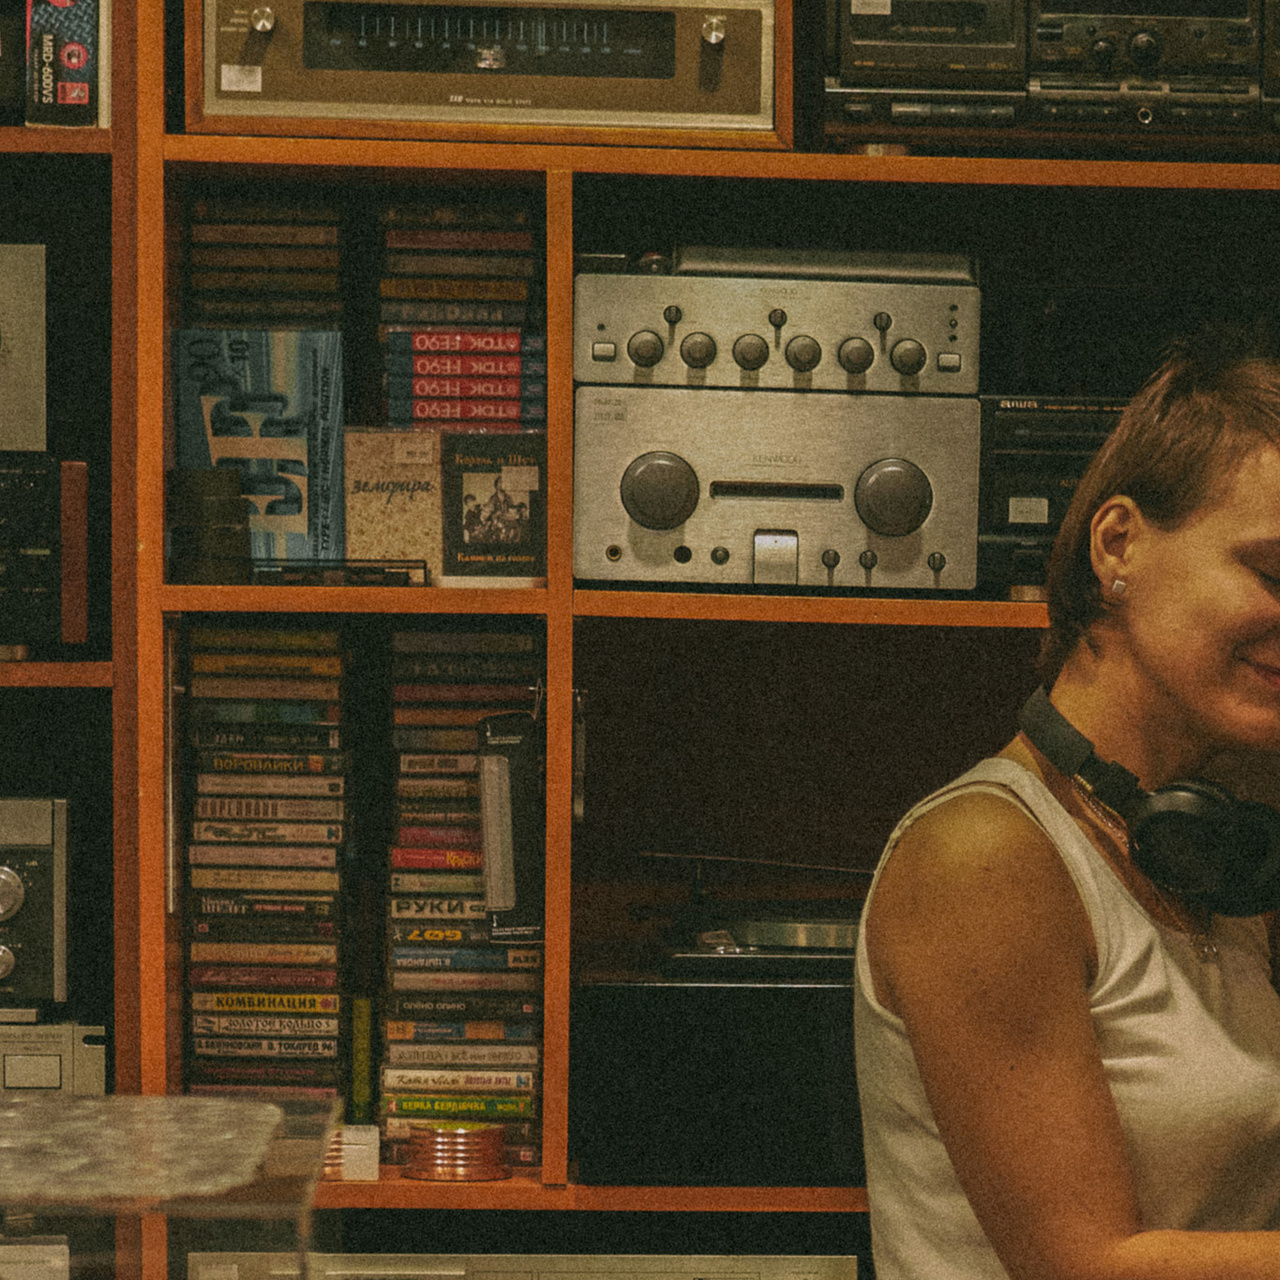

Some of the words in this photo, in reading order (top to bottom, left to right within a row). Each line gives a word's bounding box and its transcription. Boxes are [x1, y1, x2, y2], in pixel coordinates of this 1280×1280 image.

[415, 334, 461, 350] FE90
[470, 337, 506, 350] TDK
[415, 359, 461, 374] FE90
[470, 361, 506, 374] TDK
[415, 381, 461, 395] FE90
[470, 383, 506, 395] TDK
[415, 403, 461, 418] FE90
[470, 404, 506, 417] TDK
[396, 901, 464, 913] РУКИ
[216, 996, 317, 1010] КОМБИНАЦИЯ
